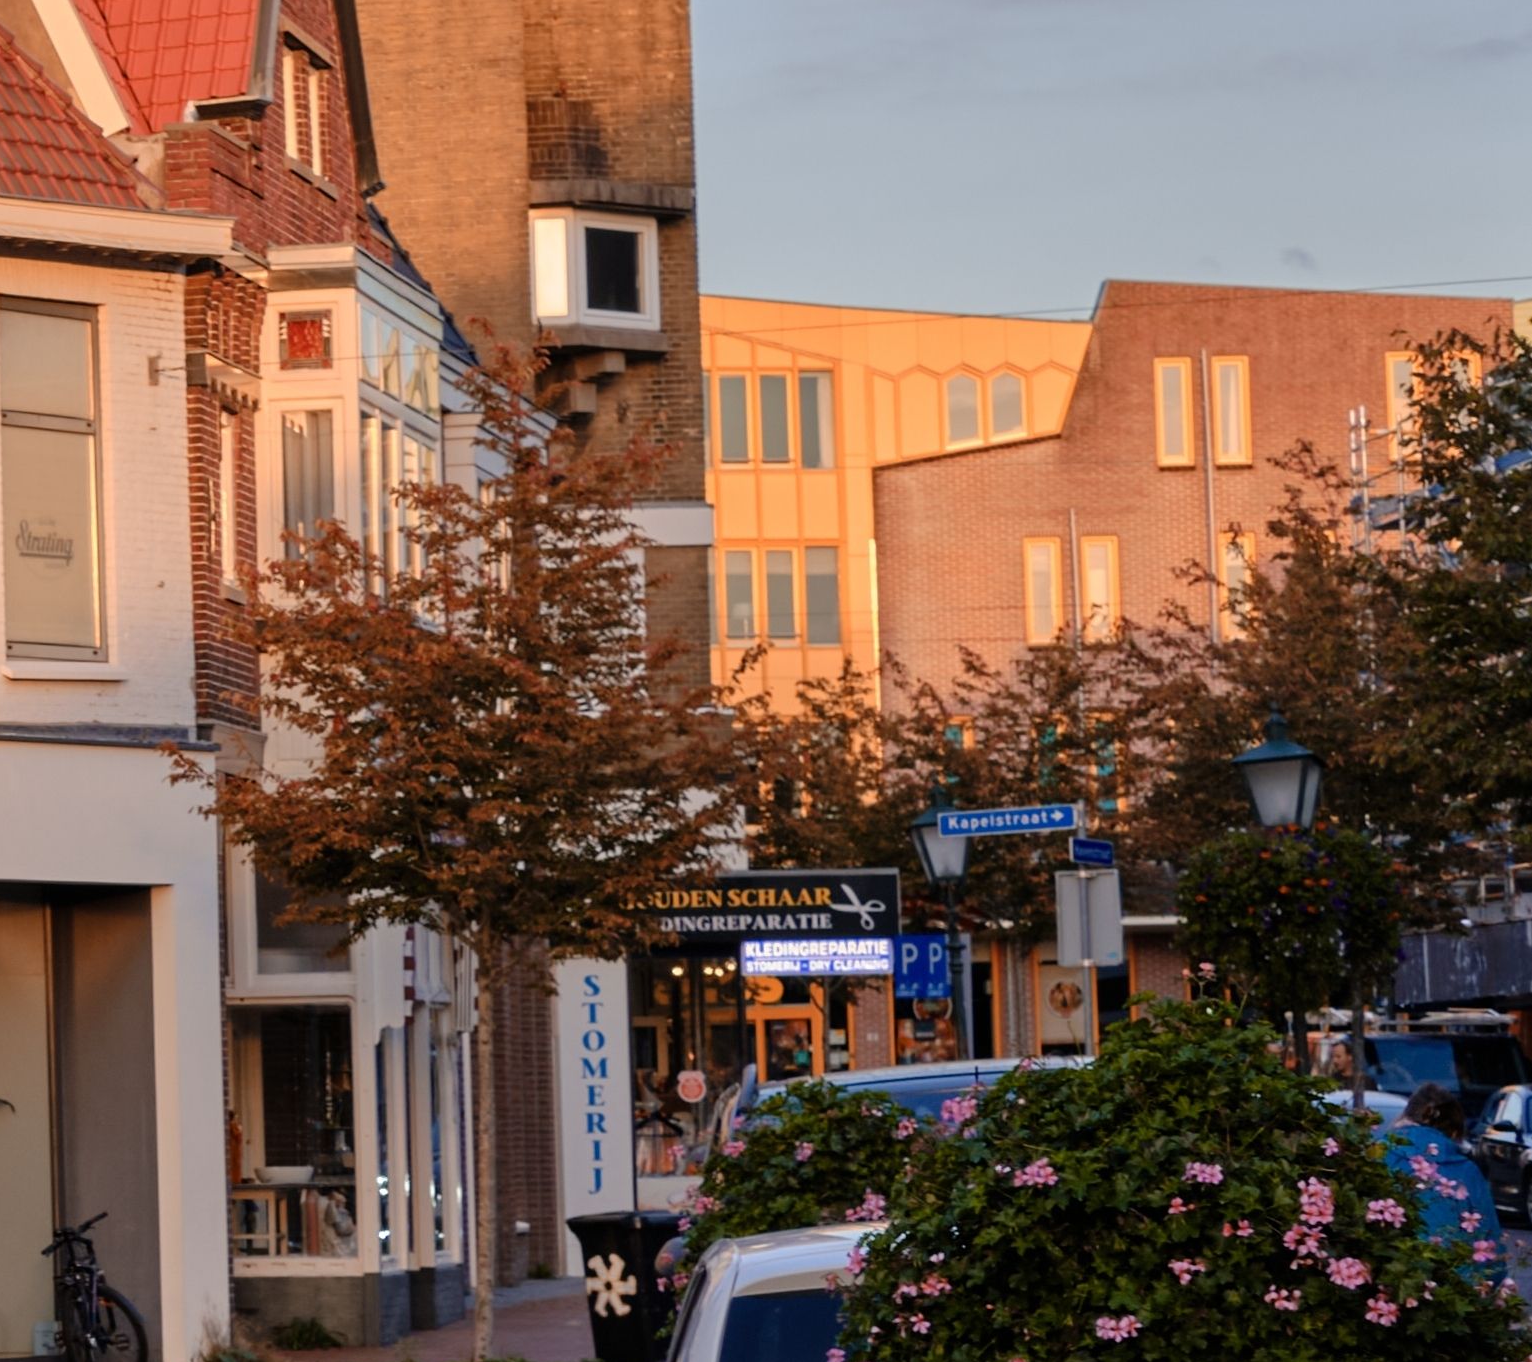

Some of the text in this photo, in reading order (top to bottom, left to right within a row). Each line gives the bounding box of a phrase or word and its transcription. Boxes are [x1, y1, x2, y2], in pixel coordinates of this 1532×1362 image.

[947, 811, 1049, 831] Kapelstraat
[727, 886, 832, 909] SCHAAR
[660, 913, 833, 933] DINGREPARATIE
[745, 939, 889, 957] KLEDINGREPARATIE
[928, 941, 943, 975] P
[745, 959, 801, 974] STOMERIJ
[809, 959, 831, 973] DRY
[832, 957, 889, 973] CLEANING
[901, 942, 919, 976] P
[581, 975, 609, 1195] STOMERIJ
